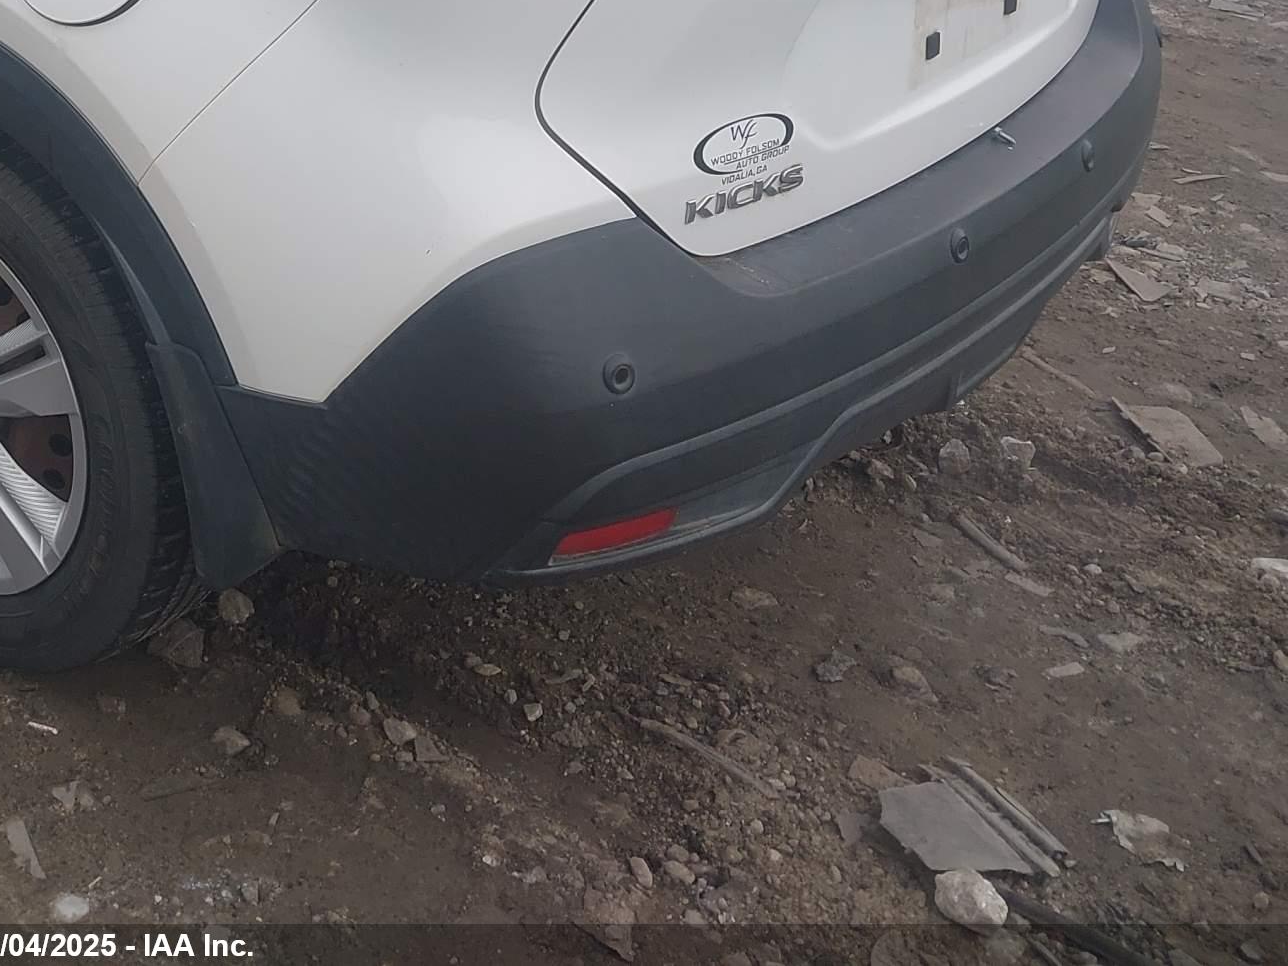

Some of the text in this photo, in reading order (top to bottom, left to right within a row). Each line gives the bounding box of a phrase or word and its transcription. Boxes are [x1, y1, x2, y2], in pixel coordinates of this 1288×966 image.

[711, 138, 780, 167] WOODY FOLSOM
[736, 144, 791, 170] AUTO GROUP
[684, 163, 805, 225] KICKS
